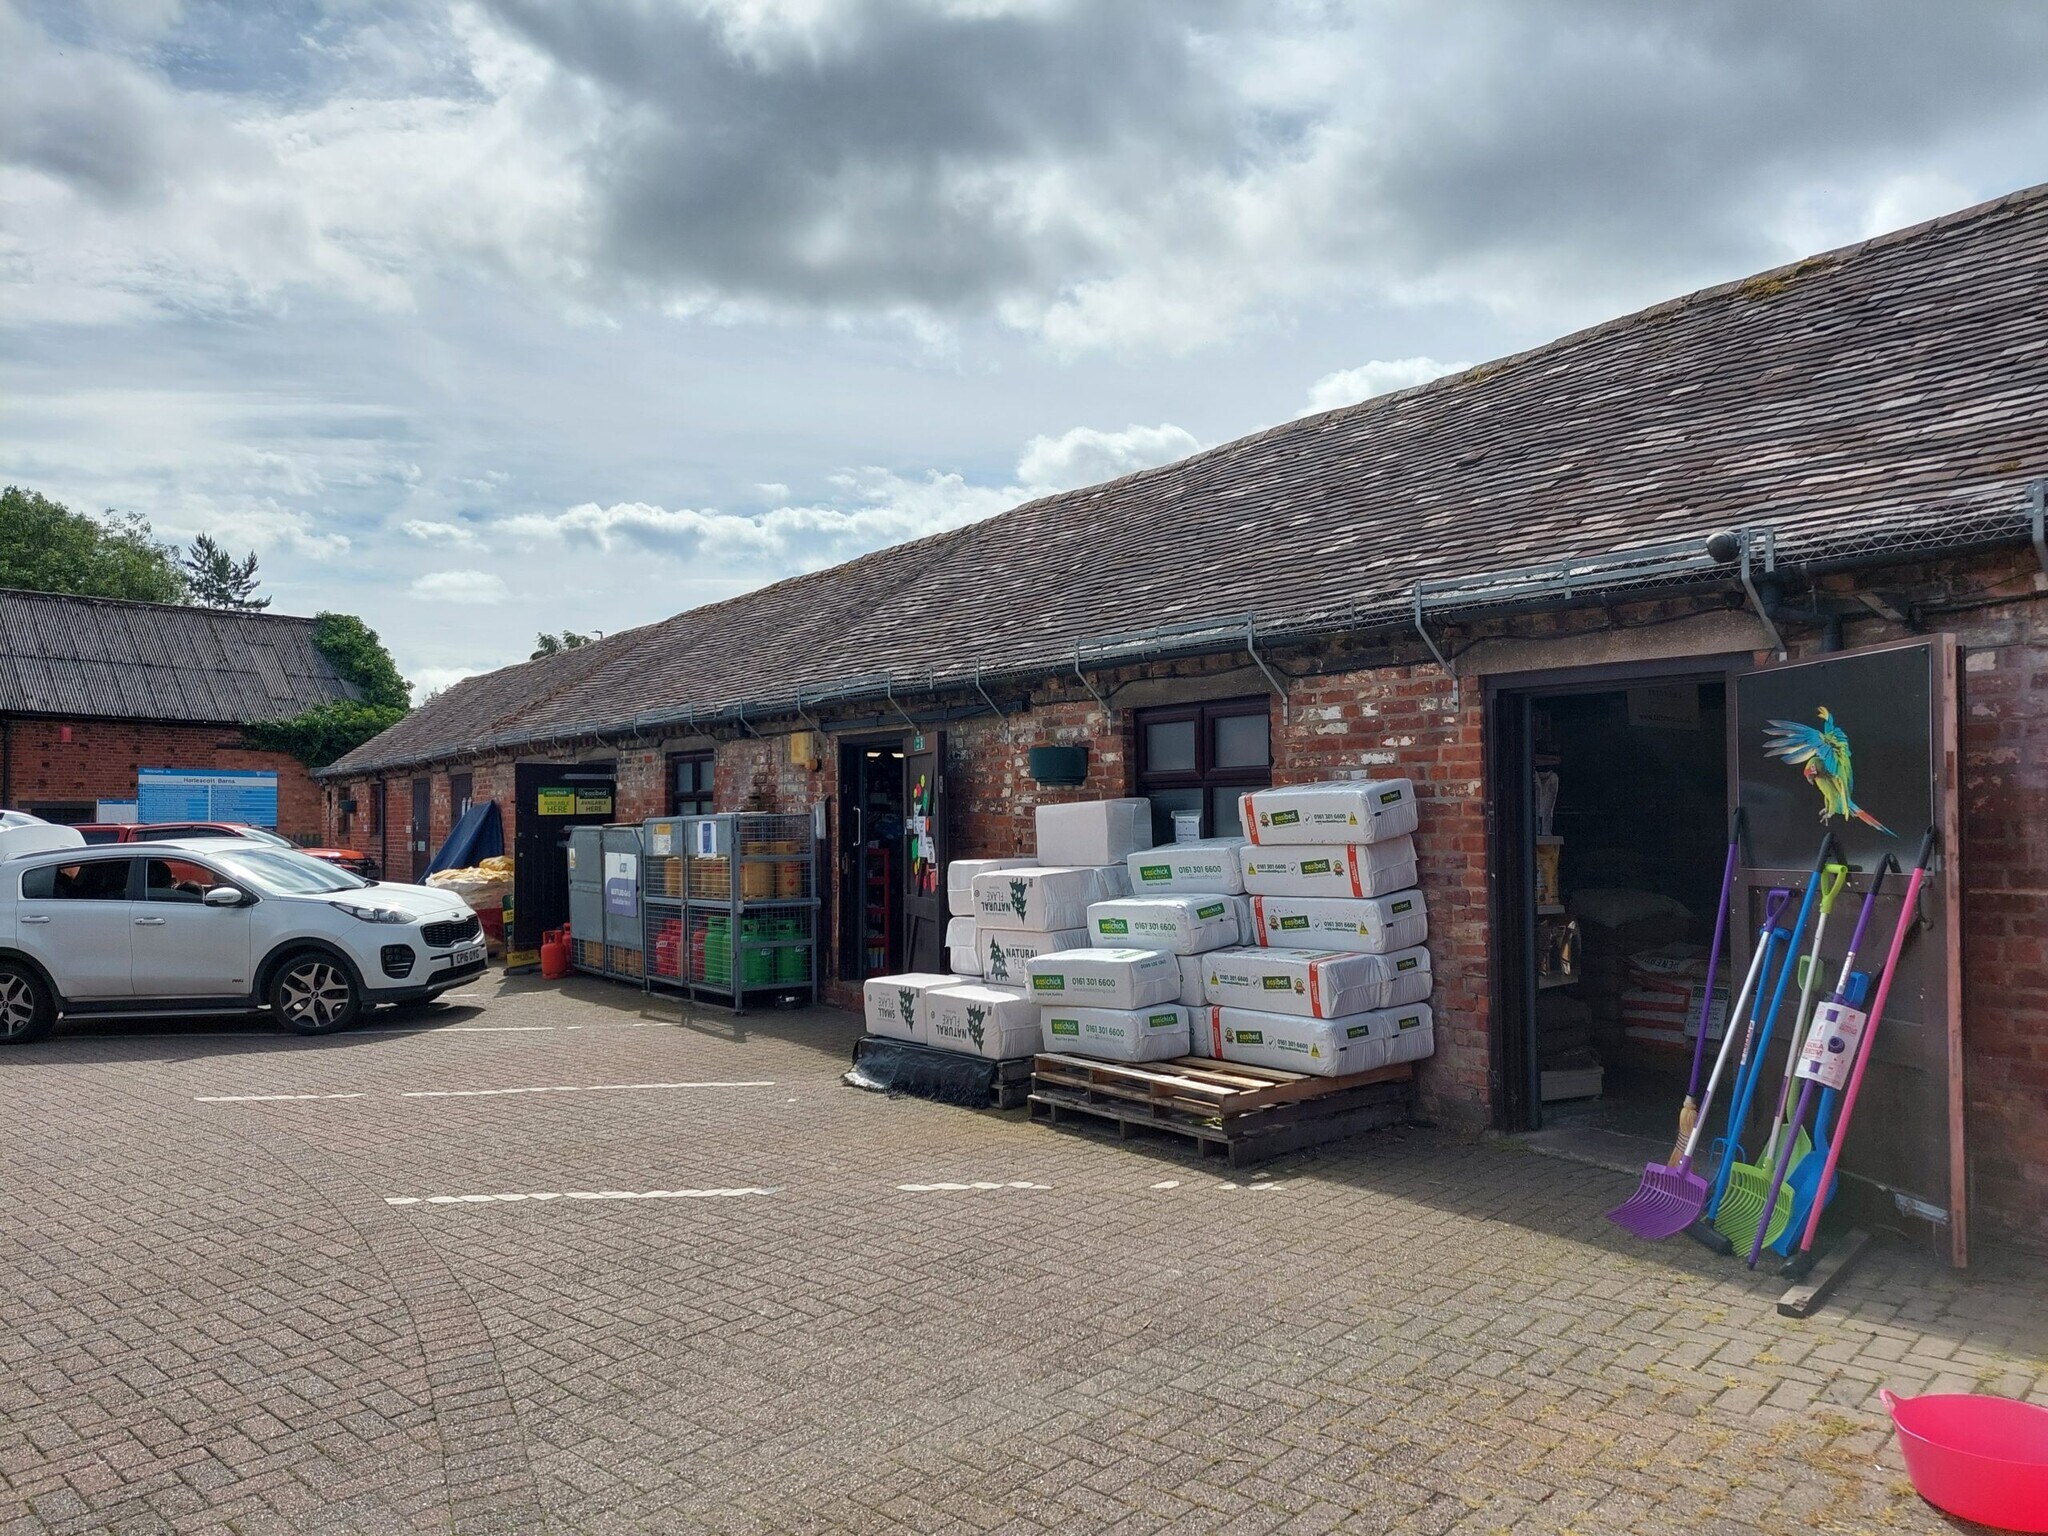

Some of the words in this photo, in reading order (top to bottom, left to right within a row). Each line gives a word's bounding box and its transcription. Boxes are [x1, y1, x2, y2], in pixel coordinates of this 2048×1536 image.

[1275, 811, 1296, 822] easibed
[1144, 867, 1169, 876] easichick
[1178, 866, 1192, 874] 0161
[1193, 865, 1204, 873] 301
[1205, 865, 1222, 873] 6600
[1304, 861, 1327, 871] easibed
[986, 891, 1004, 902] FLAKE
[980, 901, 1011, 912] NATURAL
[1134, 922, 1148, 930] 0161
[1148, 922, 1159, 930] 301
[1159, 922, 1177, 931] 6600
[456, 952, 468, 964] CP16
[1036, 976, 1062, 986] easichick
[1072, 977, 1085, 985] 0161
[1086, 978, 1097, 986] 301
[1098, 978, 1116, 987] 6600
[1266, 977, 1289, 986] easibed
[877, 997, 894, 1008] FLAKE
[877, 1008, 896, 1019] SMALL
[942, 1014, 961, 1028] FLAKE
[1053, 1022, 1077, 1031] easichick
[936, 1024, 967, 1039] NATURAL
[1085, 1024, 1098, 1033] 0161
[1098, 1025, 1108, 1034] 301
[1108, 1027, 1125, 1037] 6600
